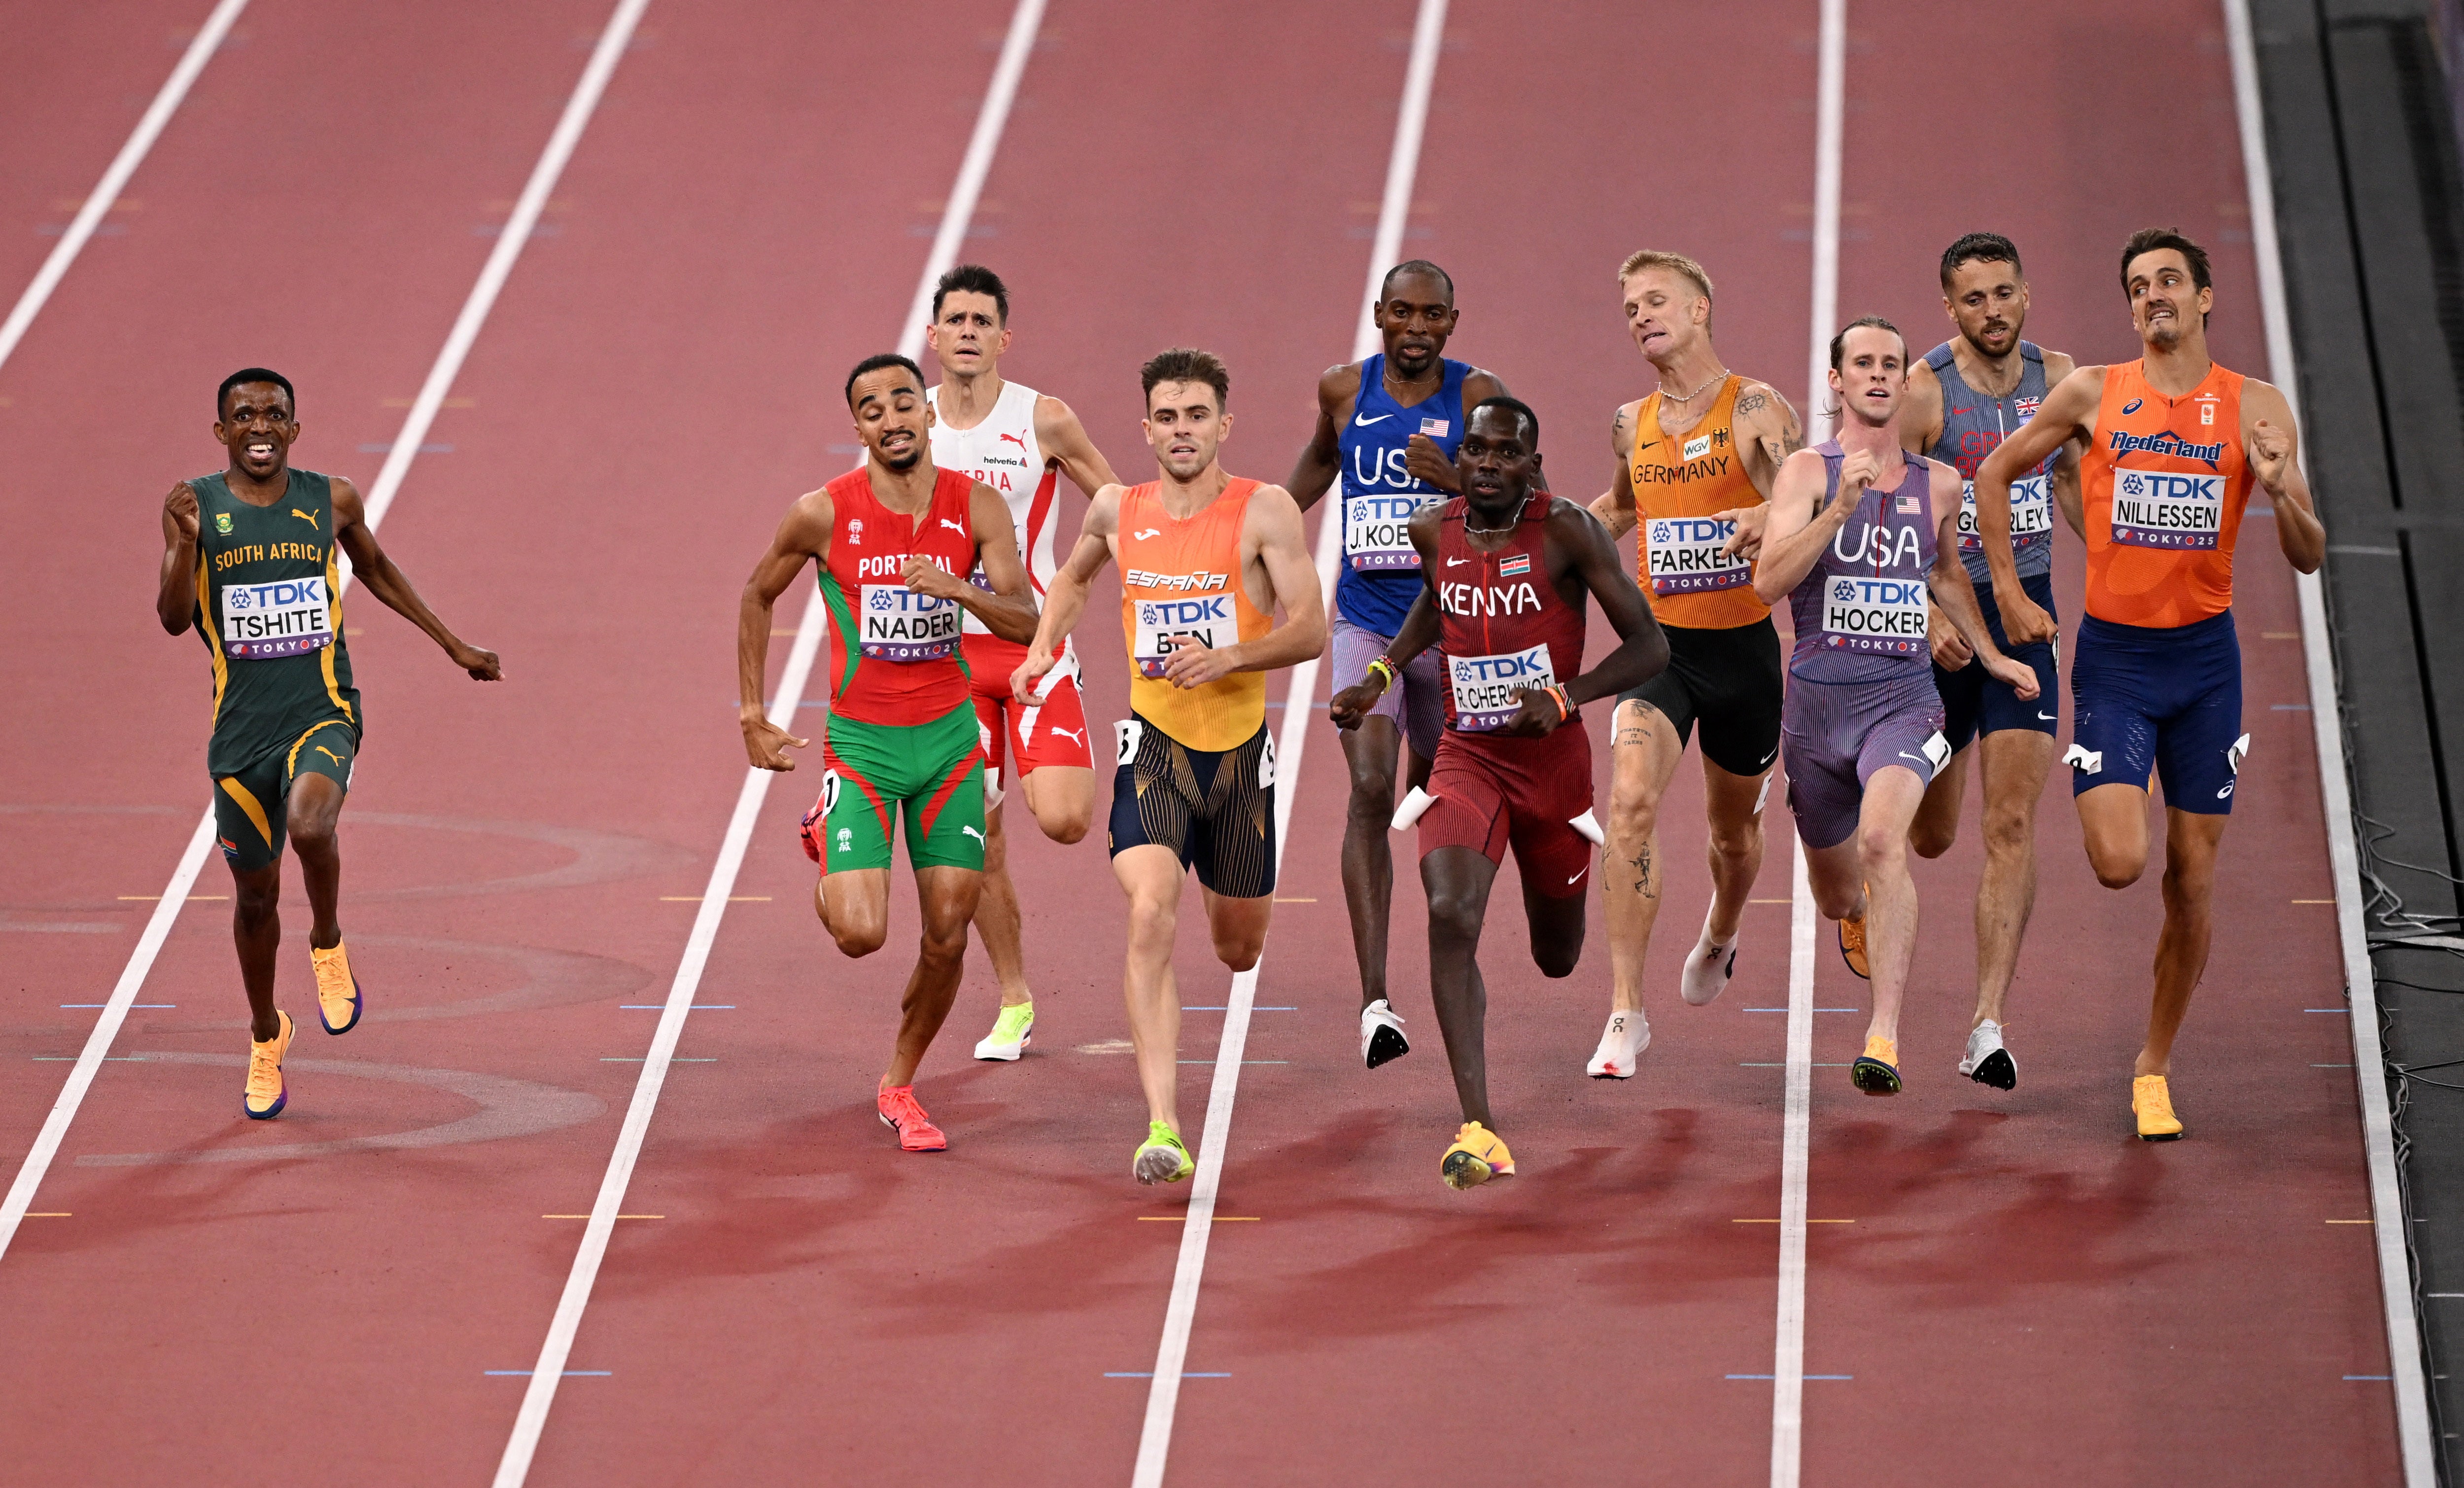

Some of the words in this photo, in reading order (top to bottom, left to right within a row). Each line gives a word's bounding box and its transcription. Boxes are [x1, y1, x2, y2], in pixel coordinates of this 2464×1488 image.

[983, 456, 1017, 465] helvetia
[1685, 439, 1709, 456] WGV
[1634, 456, 1728, 485] GERMANY
[2010, 479, 2042, 504] DK
[2144, 475, 2217, 500] TDK
[2117, 500, 2217, 529] NILLESSEN
[1670, 520, 1735, 542] TDK
[215, 544, 264, 571] SOUTH
[270, 542, 321, 563] AFRICA
[1835, 523, 1920, 568] USA
[250, 580, 320, 607] TDK
[1126, 569, 1229, 591] ESPAÑA
[1856, 581, 1921, 606] TDK
[1155, 597, 1227, 625] TDK
[1440, 581, 1541, 617] KENYA
[230, 608, 323, 638] TSHITE
[869, 612, 953, 639] NADER
[1830, 607, 1924, 635] HOCKER
[1469, 650, 1543, 681] TDK
